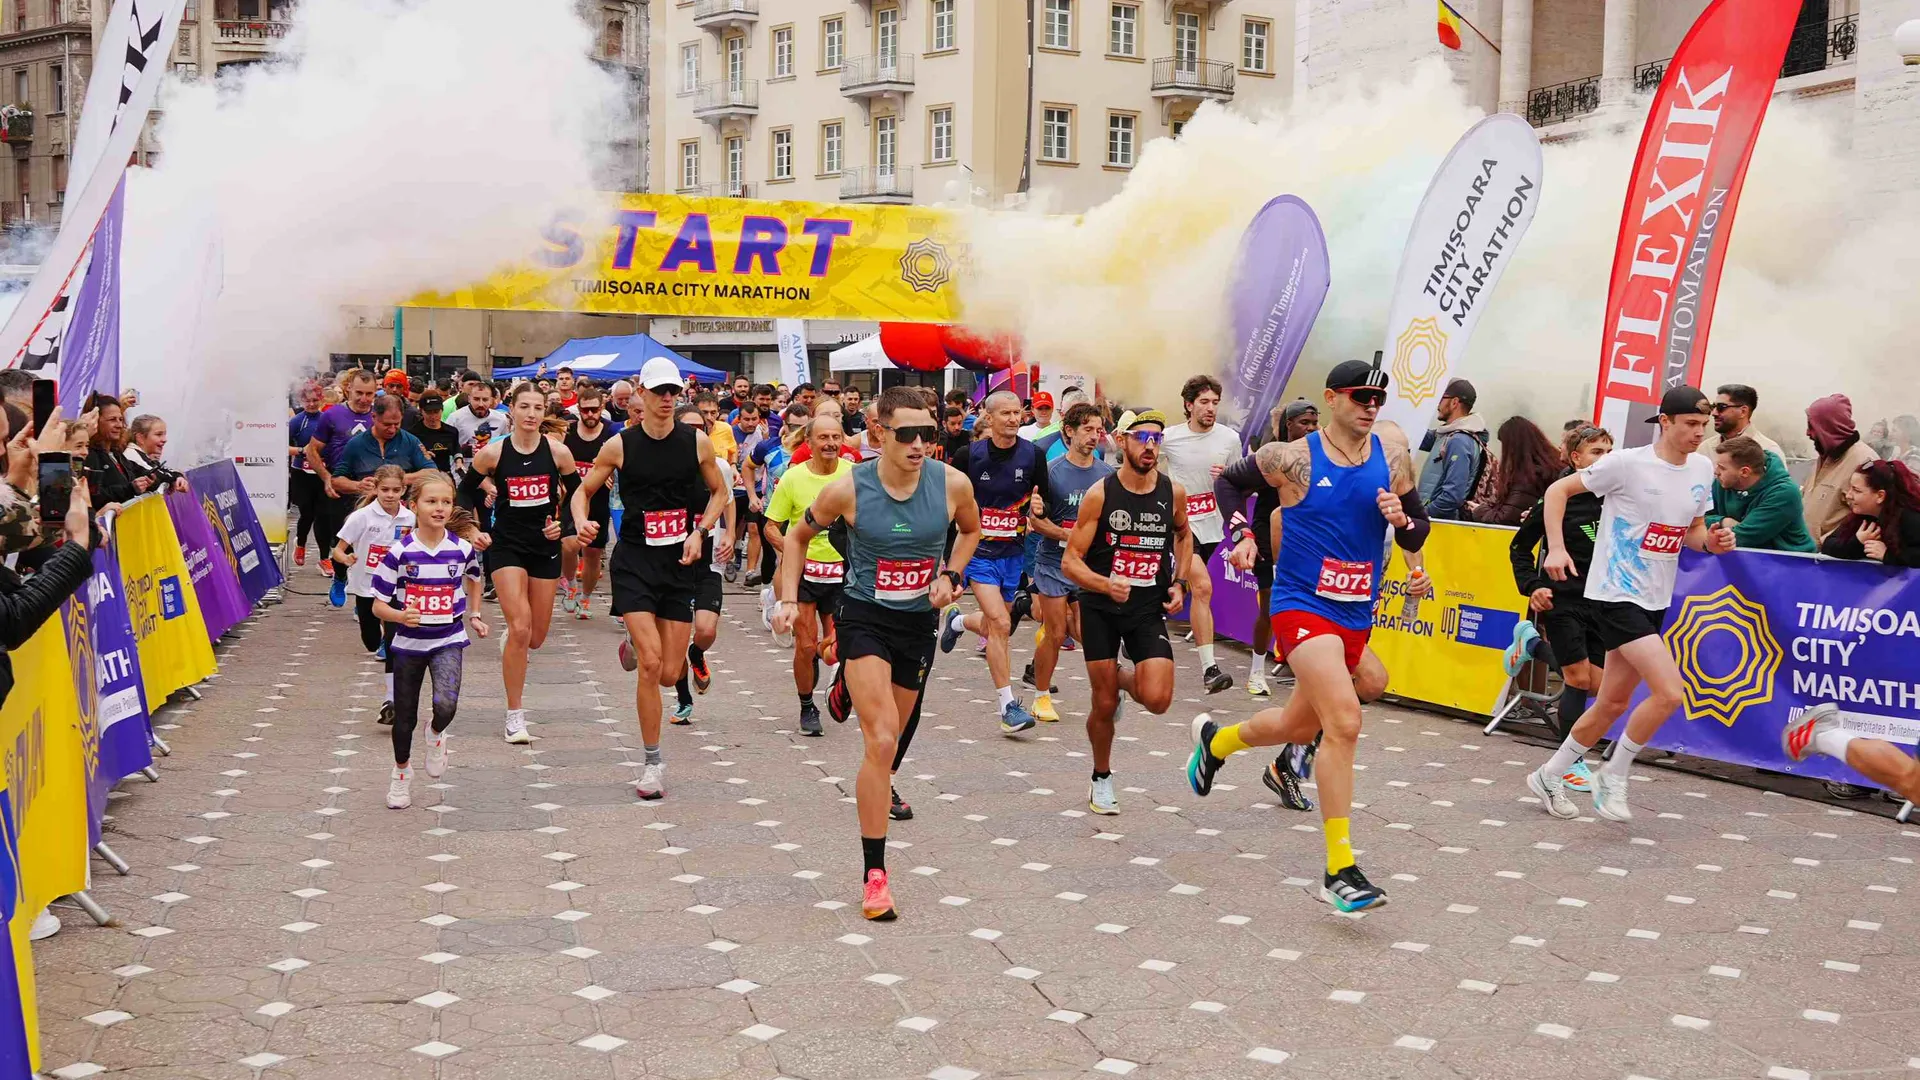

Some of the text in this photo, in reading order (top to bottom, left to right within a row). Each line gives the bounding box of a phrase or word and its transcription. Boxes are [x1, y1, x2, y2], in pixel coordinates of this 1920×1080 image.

[1606, 65, 1734, 396] FLEXIK
[530, 209, 853, 278] START
[1452, 175, 1534, 327] MARATHON
[1440, 251, 1470, 312] CITY
[1667, 187, 1729, 388] AUTOMATION
[671, 282, 711, 298] CITY
[713, 283, 811, 301] MARATHON
[1244, 318, 1279, 382] Municipiul
[246, 422, 277, 430] rompetrol
[509, 482, 549, 498] 5103
[1186, 499, 1215, 513] 5341
[982, 516, 1018, 528] 5049
[1645, 532, 1682, 549] 5071
[806, 563, 843, 576] 5174
[1114, 558, 1159, 576] 5128
[878, 568, 932, 587] 5307
[1321, 569, 1372, 591] 5073
[405, 594, 452, 611] 5183
[1372, 613, 1434, 637] ARATHON
[1791, 636, 1858, 667] CITY
[1793, 669, 1920, 710] MARATH
[1842, 717, 1887, 735] Universitatea
